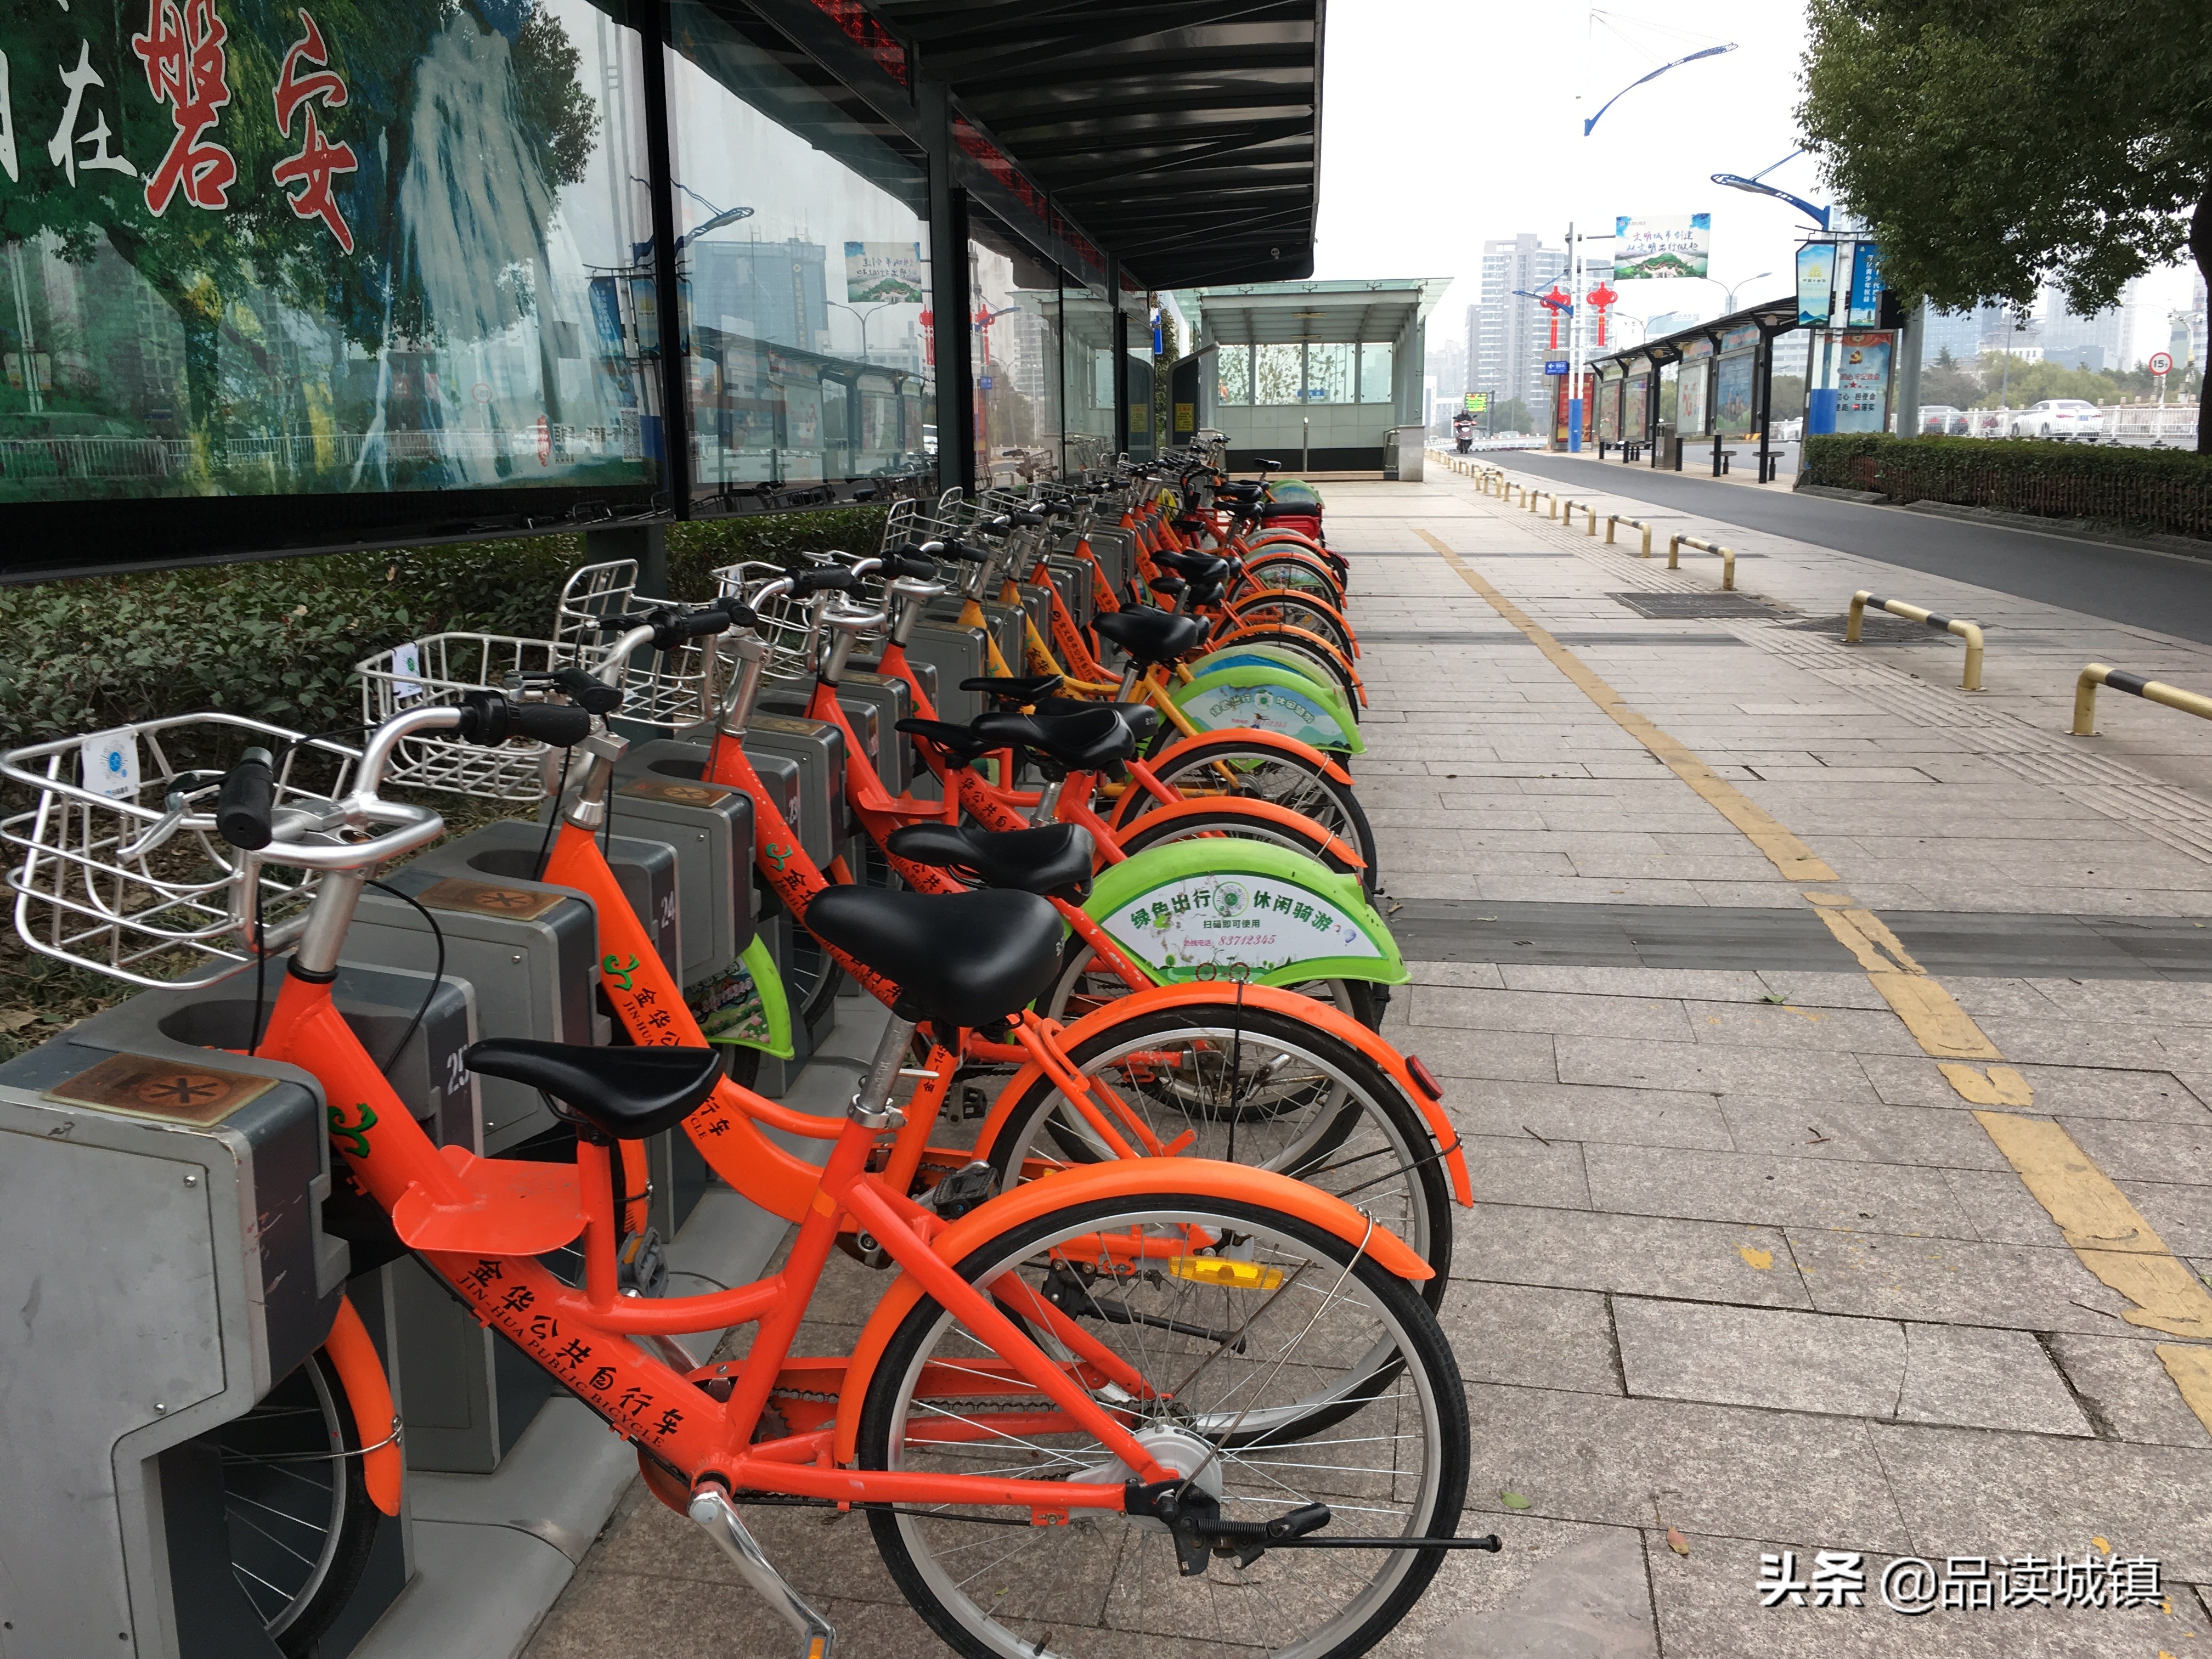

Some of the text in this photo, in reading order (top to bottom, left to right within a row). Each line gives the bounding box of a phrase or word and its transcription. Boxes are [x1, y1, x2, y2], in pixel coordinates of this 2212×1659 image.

[1627, 242, 1699, 253] 从文明出行做起
[1633, 230, 1694, 242] 文明城市创建
[661, 890, 675, 928] 24
[1131, 890, 1334, 932] 绿色出行 休闲骑游
[1203, 919, 1261, 929] 扫码即可使用
[1218, 934, 1277, 946] 83712345
[468, 1259, 685, 1436] 金华公共自行车
[457, 1276, 665, 1448] JIN-HUA PUBLIC BICYCLE
